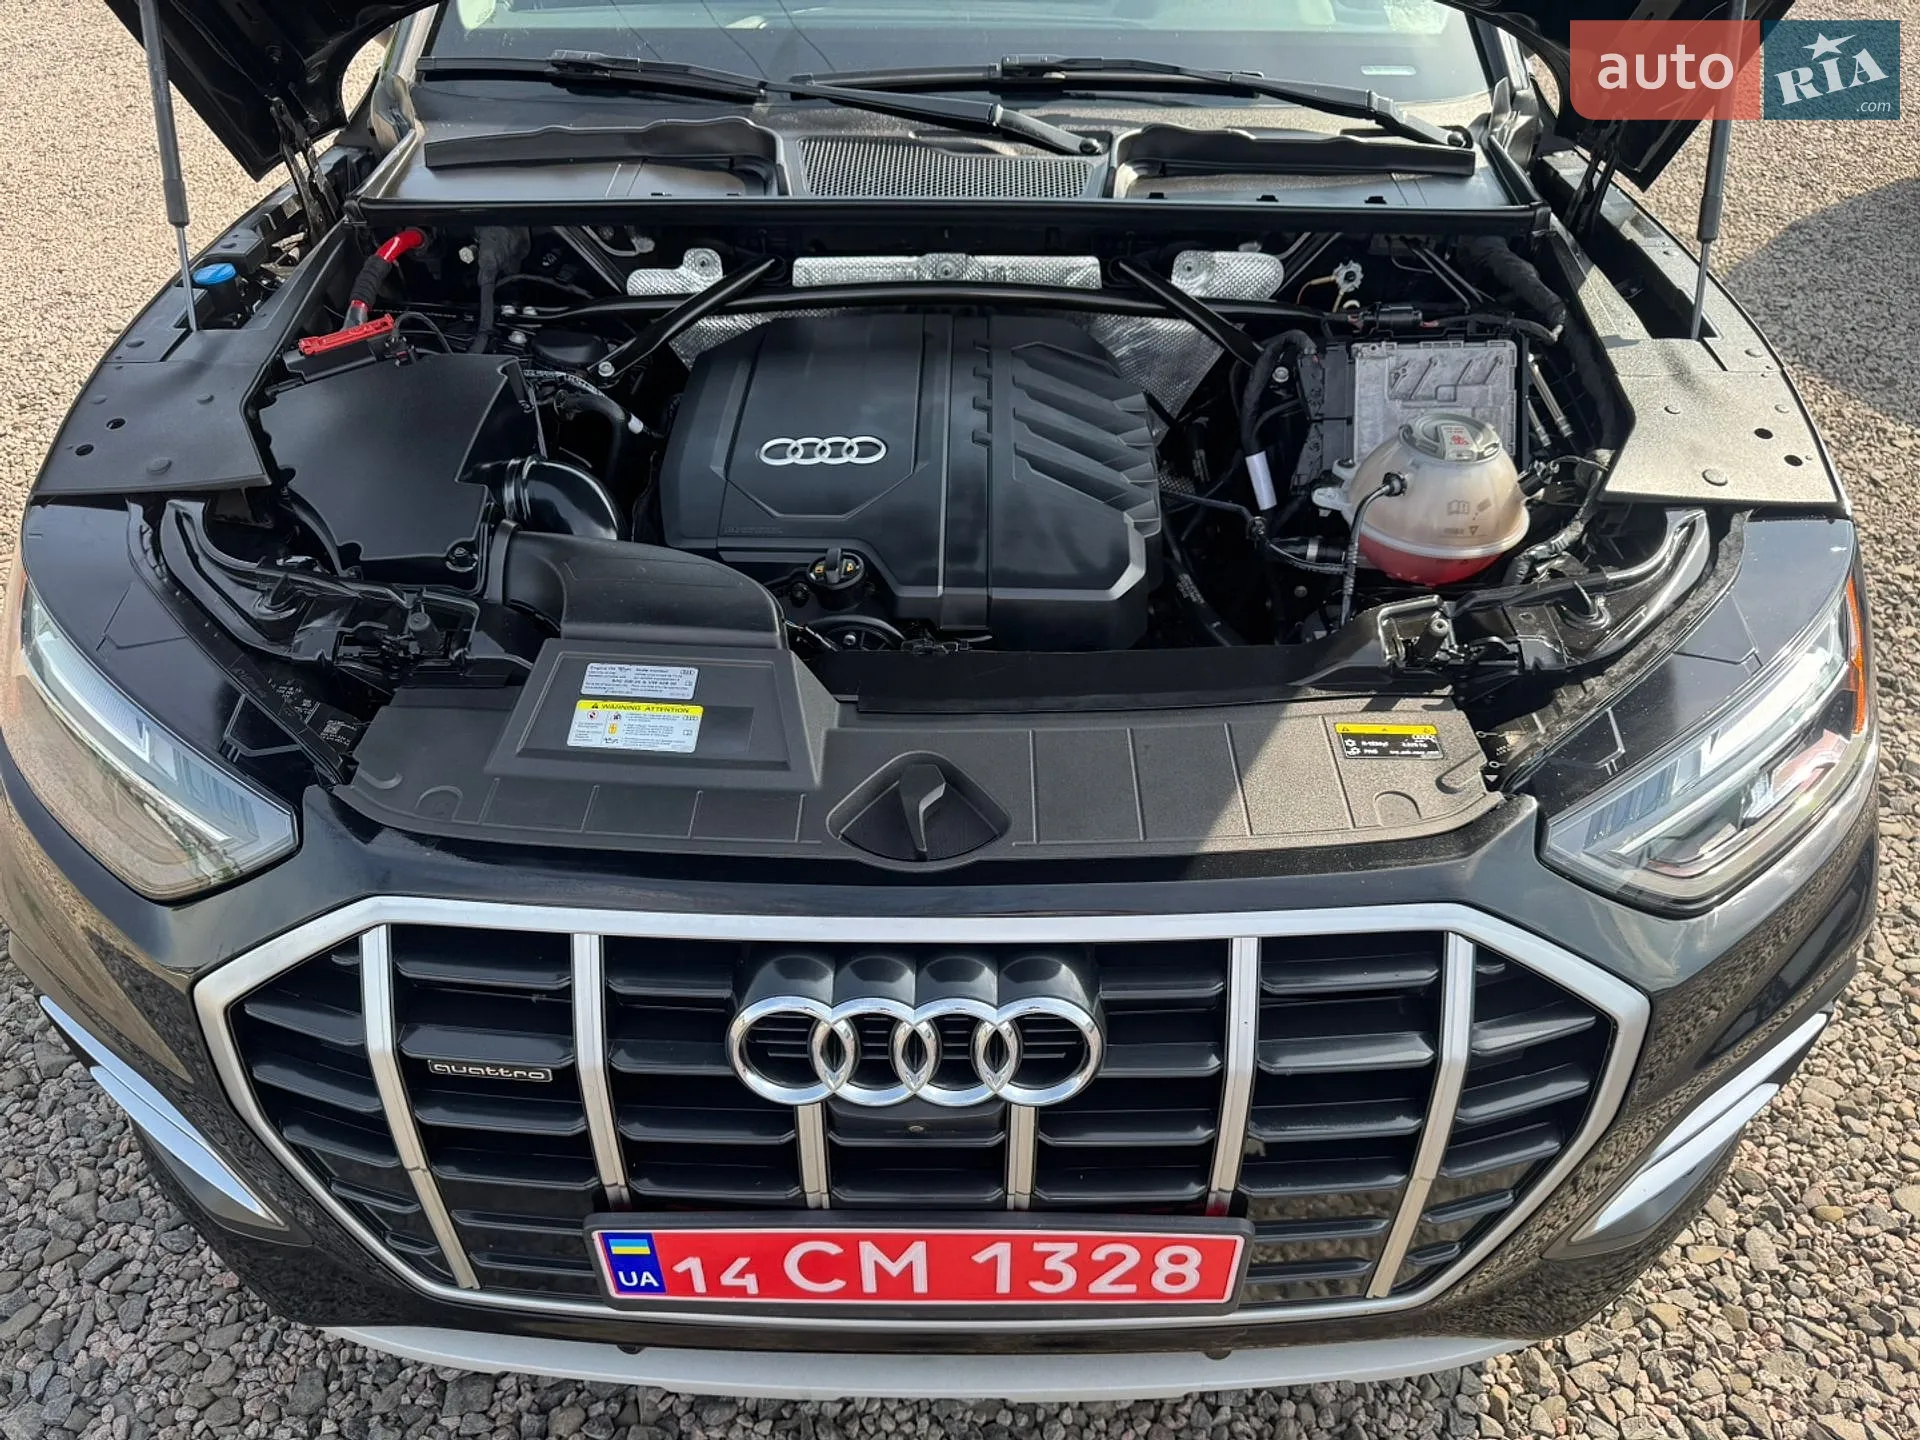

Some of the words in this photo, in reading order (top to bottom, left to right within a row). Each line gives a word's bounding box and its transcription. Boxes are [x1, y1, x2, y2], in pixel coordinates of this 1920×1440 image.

[602, 703, 641, 711] WARNING
[645, 705, 690, 714] ATTENTION
[433, 1063, 545, 1080] quattro
[673, 1256, 759, 1295] 14
[783, 1240, 929, 1294] CM
[971, 1241, 1201, 1294] 1328
[618, 1270, 659, 1289] UA
